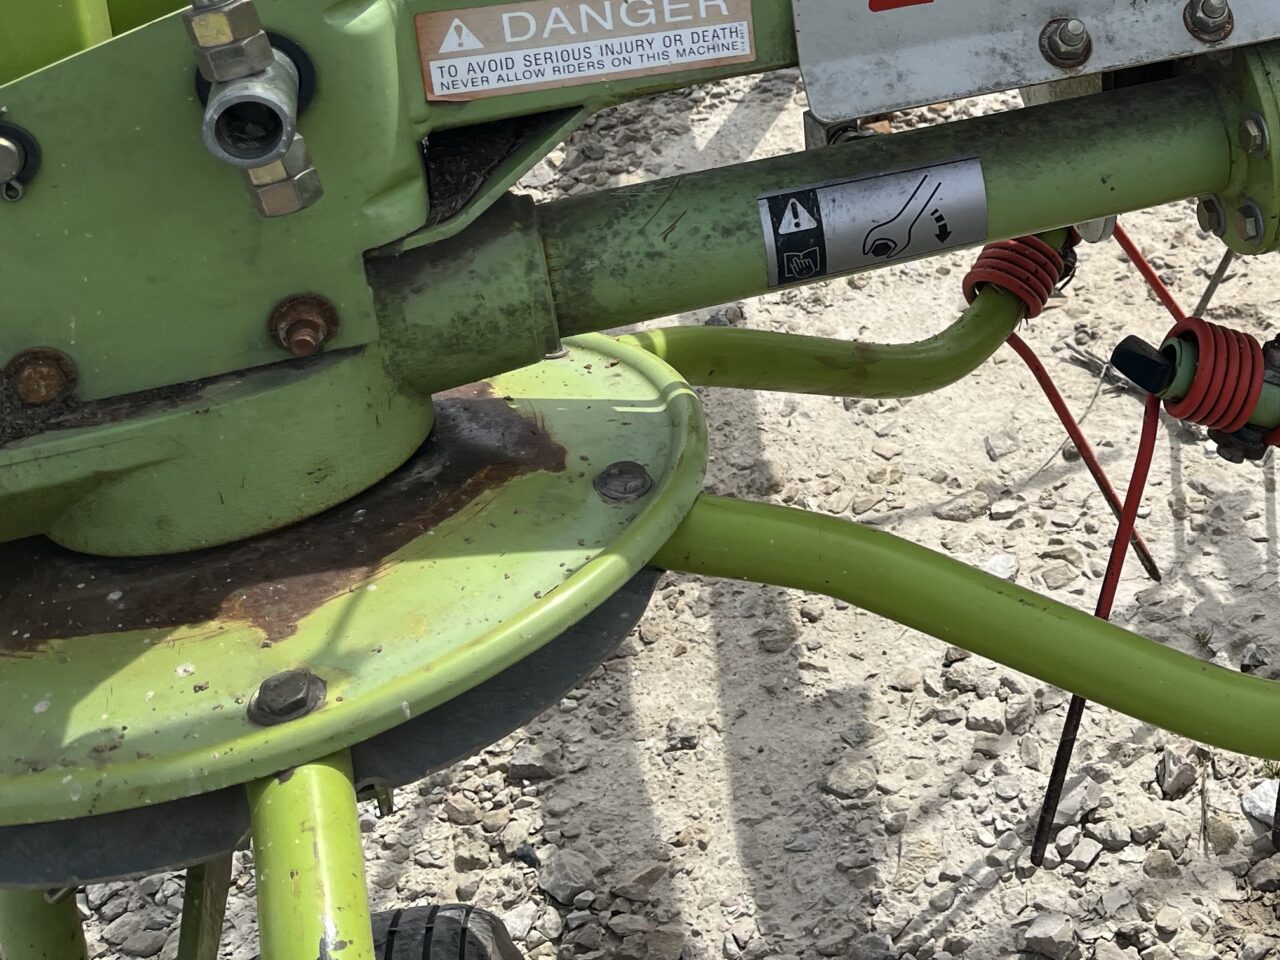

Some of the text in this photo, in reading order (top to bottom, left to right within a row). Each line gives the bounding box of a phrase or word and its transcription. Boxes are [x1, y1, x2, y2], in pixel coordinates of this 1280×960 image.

[437, 26, 739, 79] TO AVOID SERIOUS INJURY OR DEATH
[440, 40, 740, 91] NEVER ALLOW RIDERS ON THIS MACHINE
